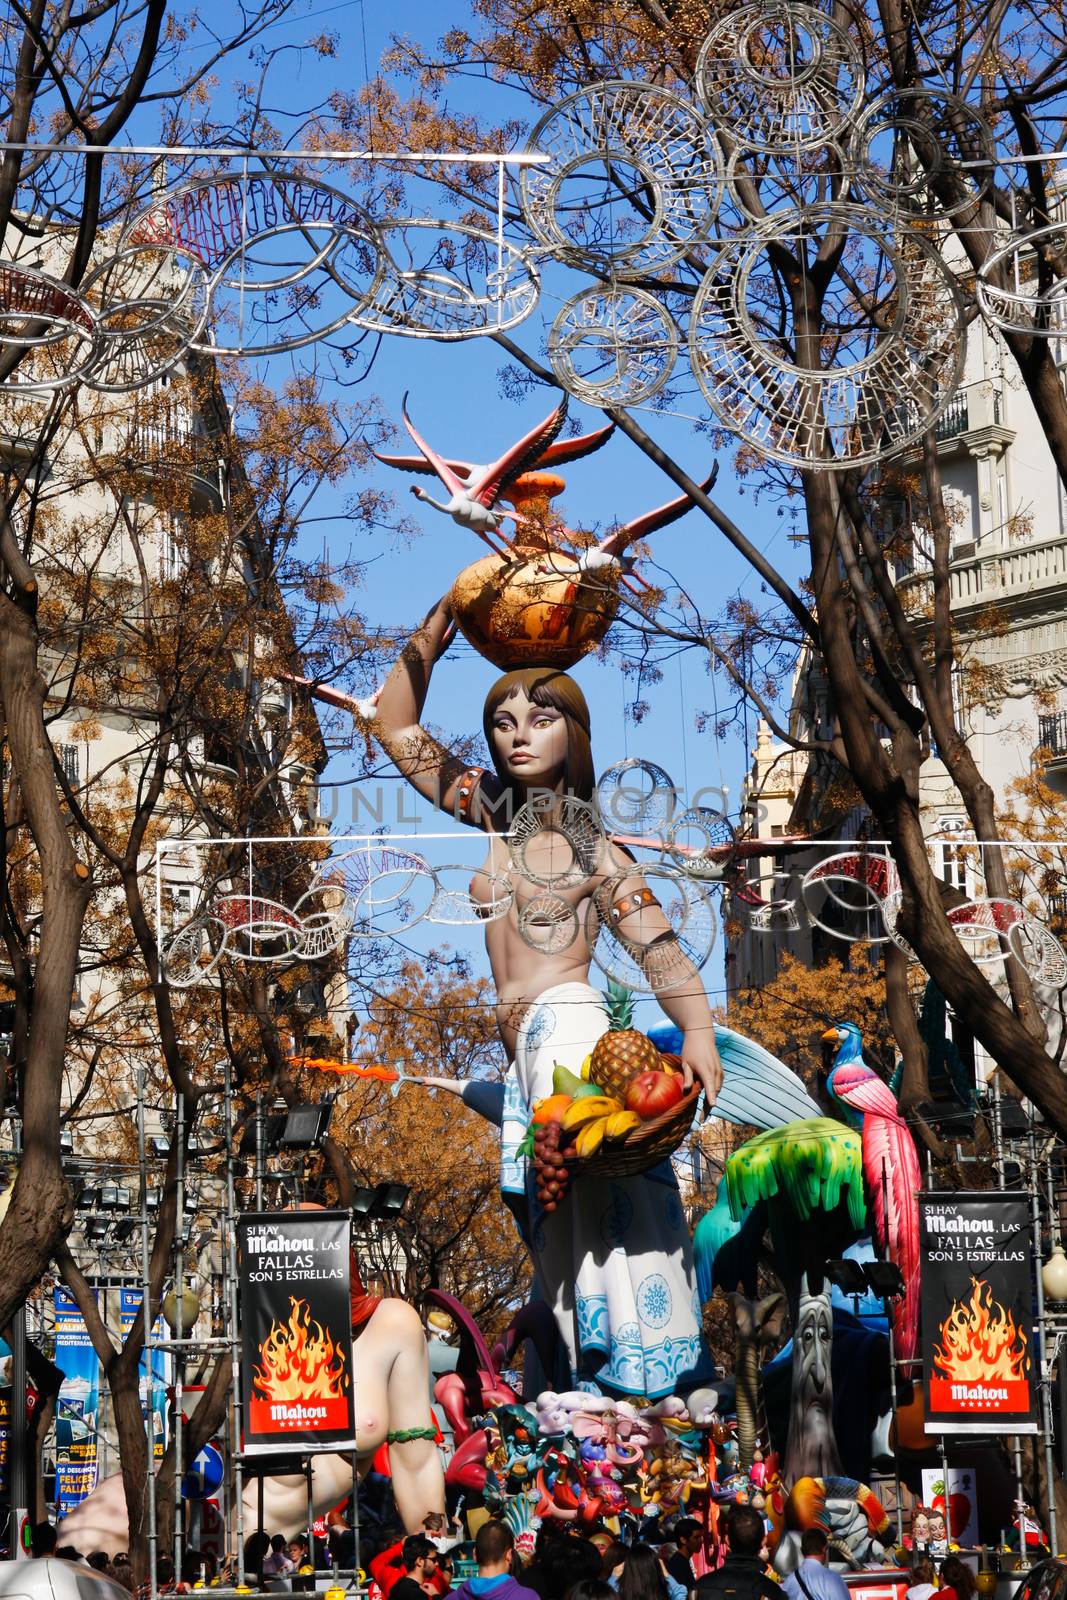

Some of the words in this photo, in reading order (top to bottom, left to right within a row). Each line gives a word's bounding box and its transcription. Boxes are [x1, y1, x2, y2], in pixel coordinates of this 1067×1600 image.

[924, 1205, 934, 1215] SI
[936, 1205, 958, 1215] HAY
[247, 1226, 256, 1236] SI
[258, 1226, 279, 1236] HAY
[1001, 1223, 1021, 1232] LAS
[321, 1241, 341, 1251] LAS
[938, 1236, 994, 1250] FALLAS
[928, 1251, 953, 1261] SON
[956, 1251, 964, 1261] 5
[966, 1251, 1025, 1261] ESTRELLAS
[258, 1255, 314, 1270] FALLAS
[249, 1271, 273, 1282] SON
[275, 1271, 283, 1281] 5
[286, 1269, 344, 1281] ESTRELLAS
[950, 1384, 1008, 1400] Mahou
[270, 1404, 327, 1420] Mahou
[60, 1483, 93, 1494] FALLAS
